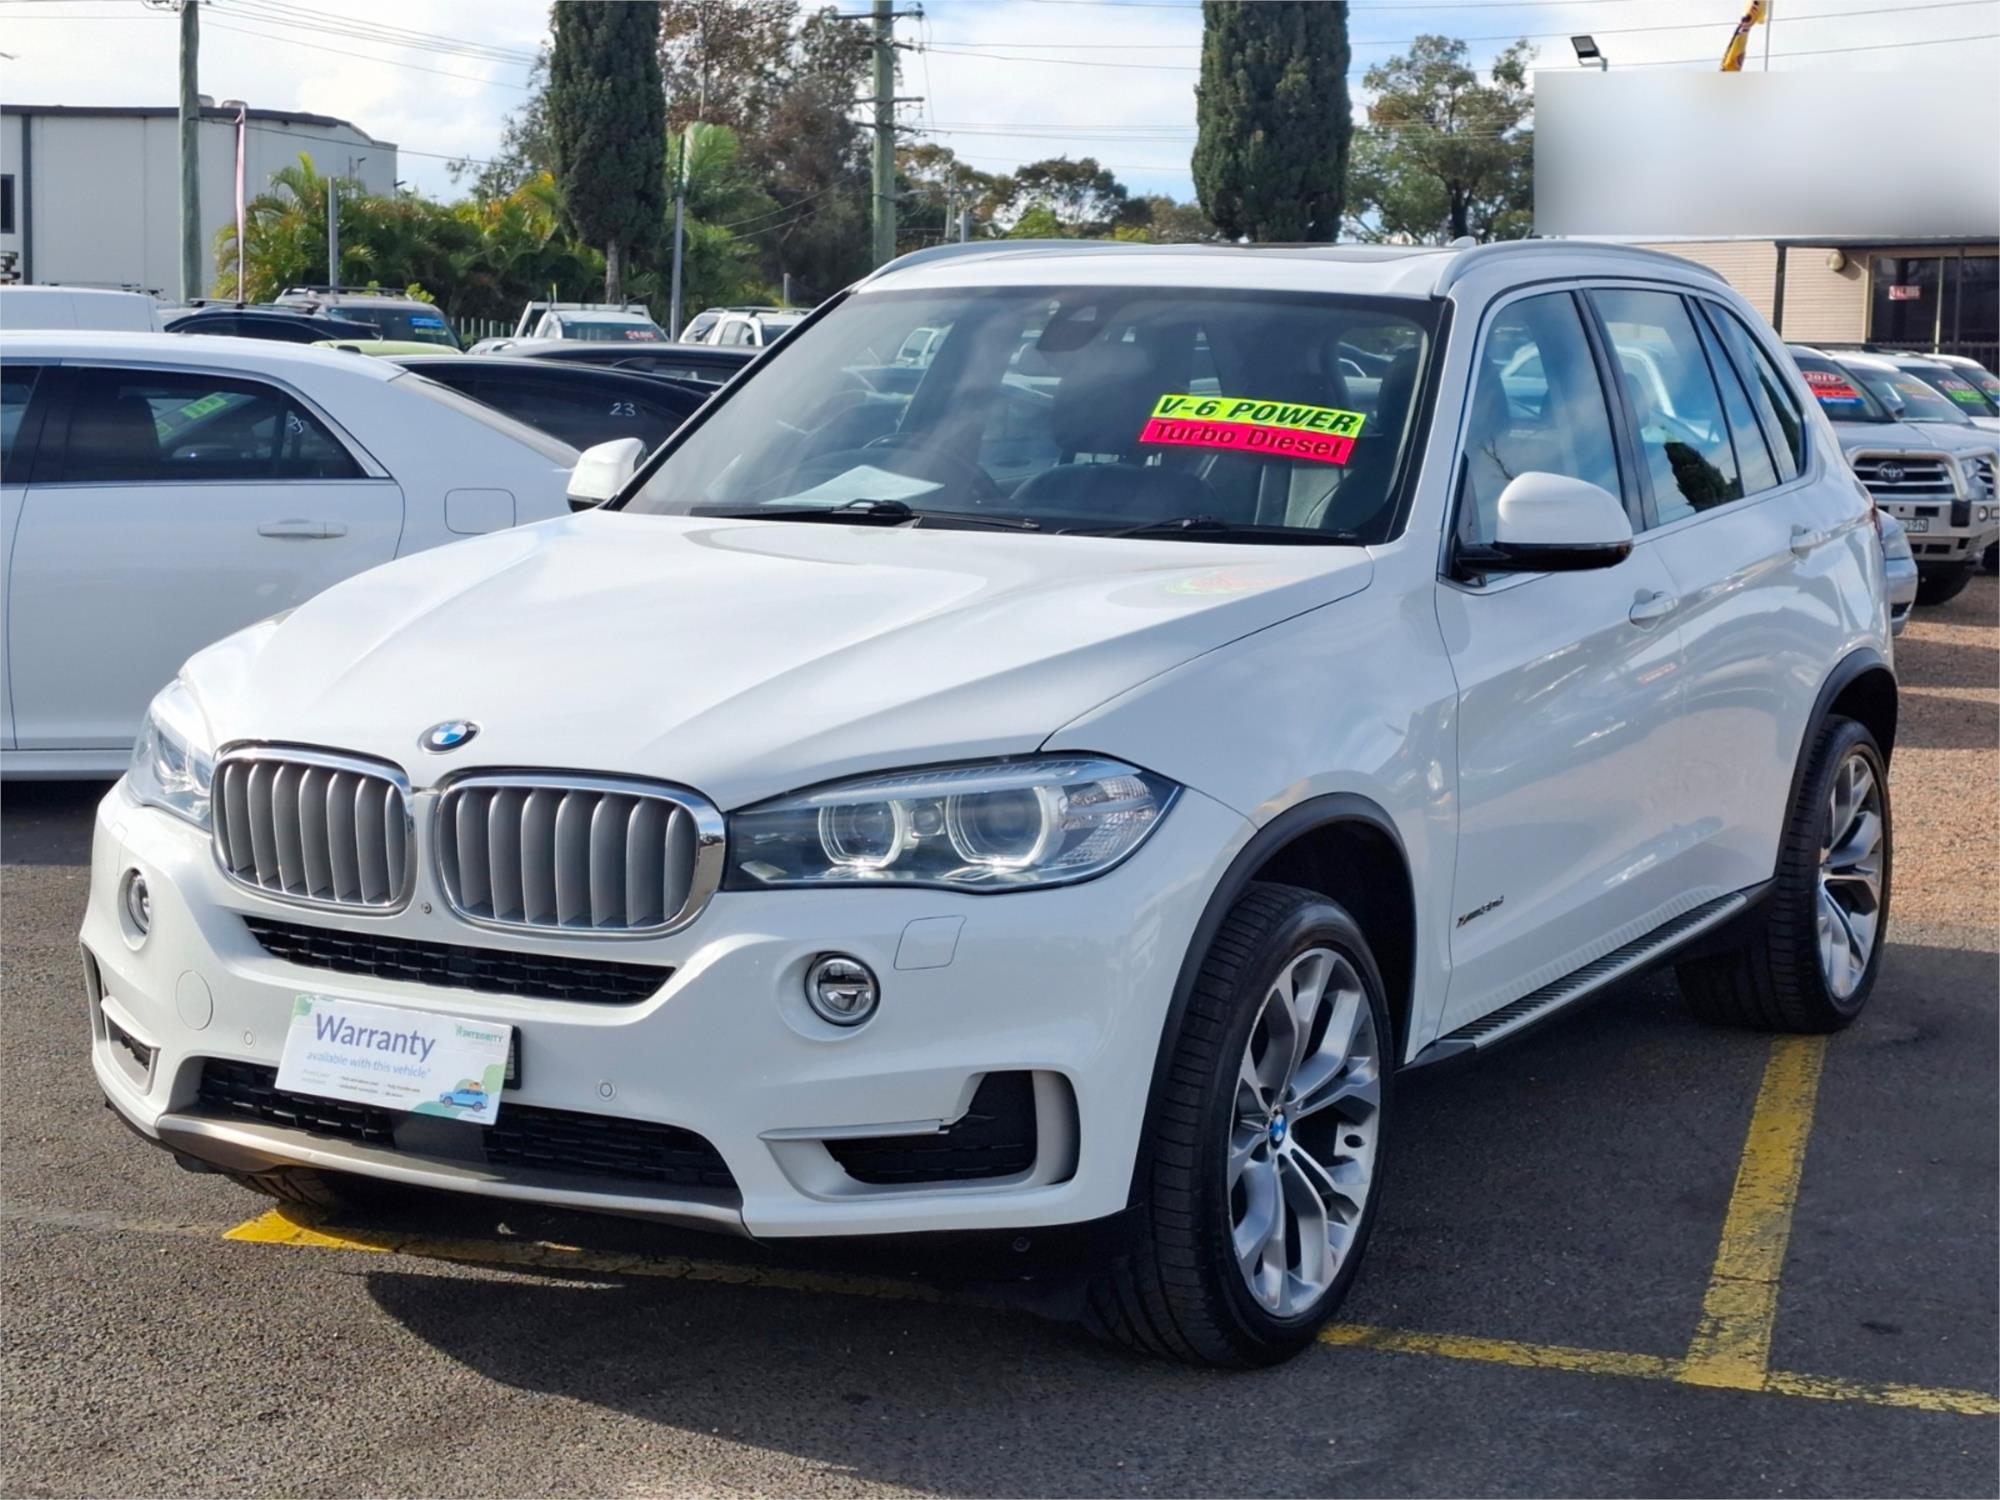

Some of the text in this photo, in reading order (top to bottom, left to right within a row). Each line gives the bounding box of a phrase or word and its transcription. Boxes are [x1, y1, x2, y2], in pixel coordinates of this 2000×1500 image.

[609, 402, 636, 417] 23
[1159, 398, 1357, 432] V-6 POWER
[1156, 422, 1342, 457] Turbo Diesel
[316, 1013, 436, 1063] Warranty
[306, 1051, 348, 1067] available
[350, 1056, 371, 1069] with
[373, 1058, 391, 1074] this
